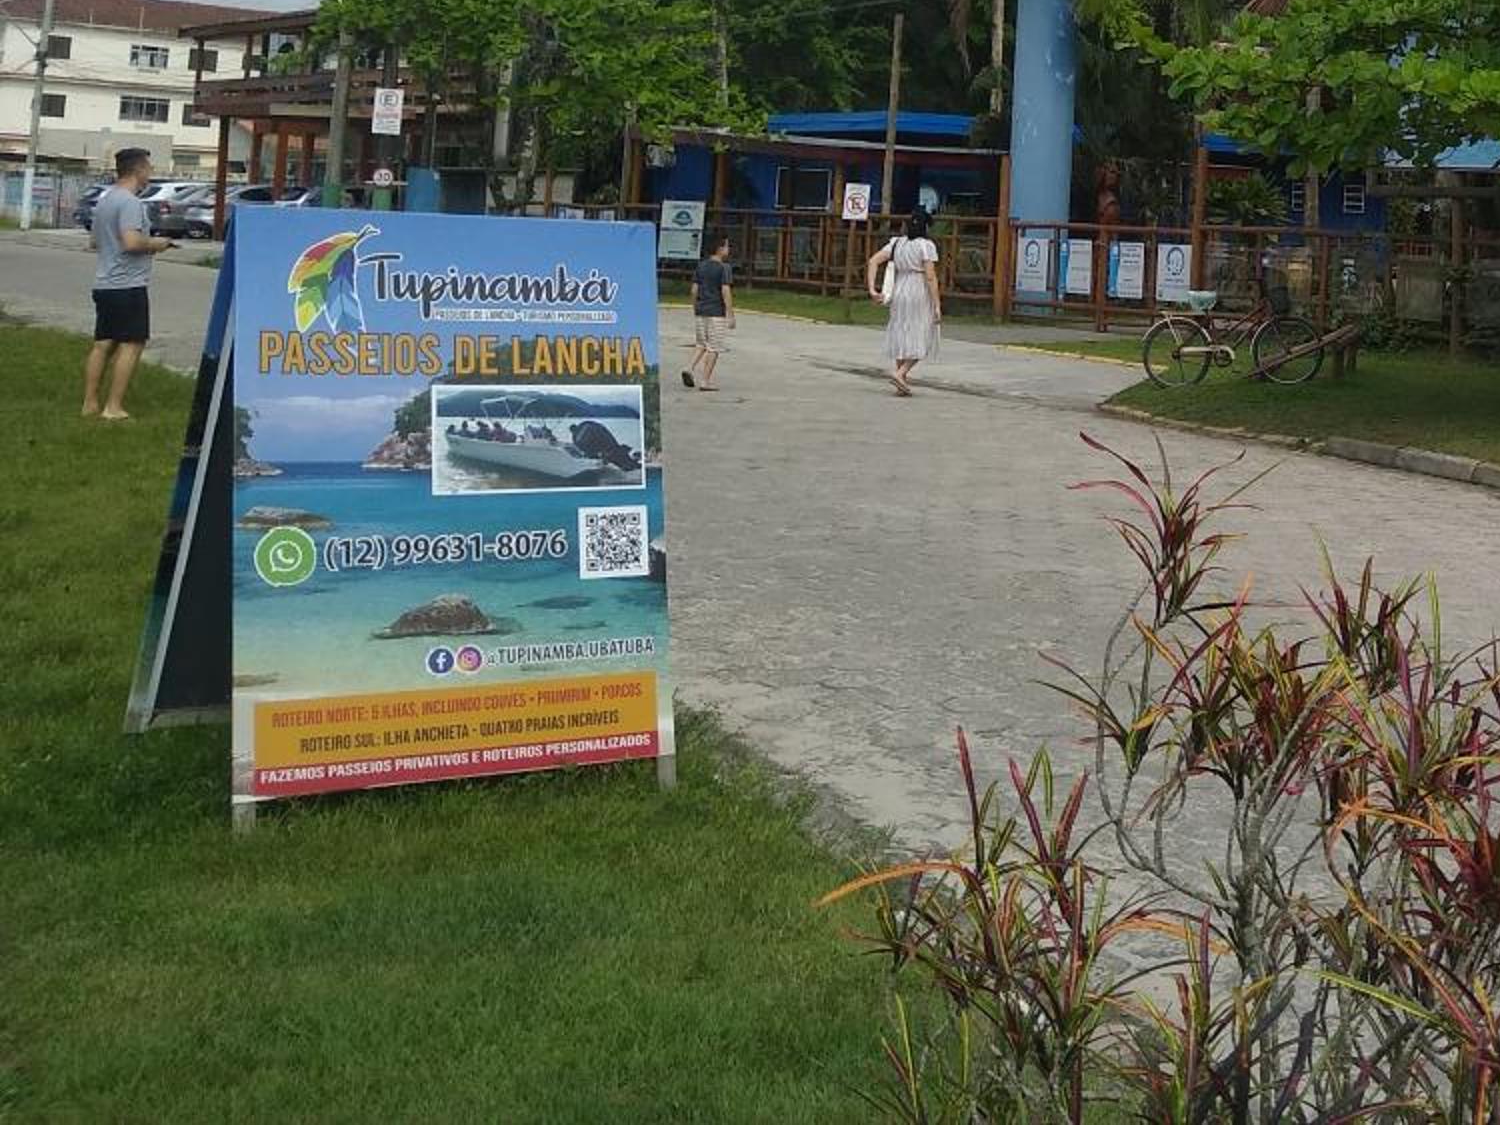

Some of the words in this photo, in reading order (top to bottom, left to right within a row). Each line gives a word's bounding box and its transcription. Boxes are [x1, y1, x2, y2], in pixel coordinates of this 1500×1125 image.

[360, 254, 616, 318] Tupinambá
[259, 330, 442, 376] PASSEIOS
[454, 335, 498, 376] DE
[512, 335, 646, 376] LANCHA
[325, 535, 386, 571] (12)
[393, 530, 568, 564] 99631-8076
[272, 709, 323, 728] ROTEIRO
[326, 706, 368, 724] NORTE:
[382, 703, 418, 719] ILHAS,
[422, 695, 481, 715] INCLUINDO
[484, 692, 526, 710] COUVES
[601, 682, 642, 700] PORCOS
[301, 733, 350, 753] ROTEIRO
[354, 732, 381, 748] SUL:
[383, 729, 411, 746] ILHA
[414, 724, 469, 743] ANCHIETA
[479, 719, 523, 737] QUATRO
[526, 716, 565, 732] PRAIAS
[567, 708, 619, 728] INCRÍVEIS
[261, 766, 325, 784] FAZEMOS
[328, 758, 391, 778] PASSEIOS
[395, 751, 469, 772] PRIVATIVOS
[471, 750, 481, 764] E
[483, 743, 544, 763] ROTEIROS
[546, 733, 651, 757] PERSONALIZADOS
